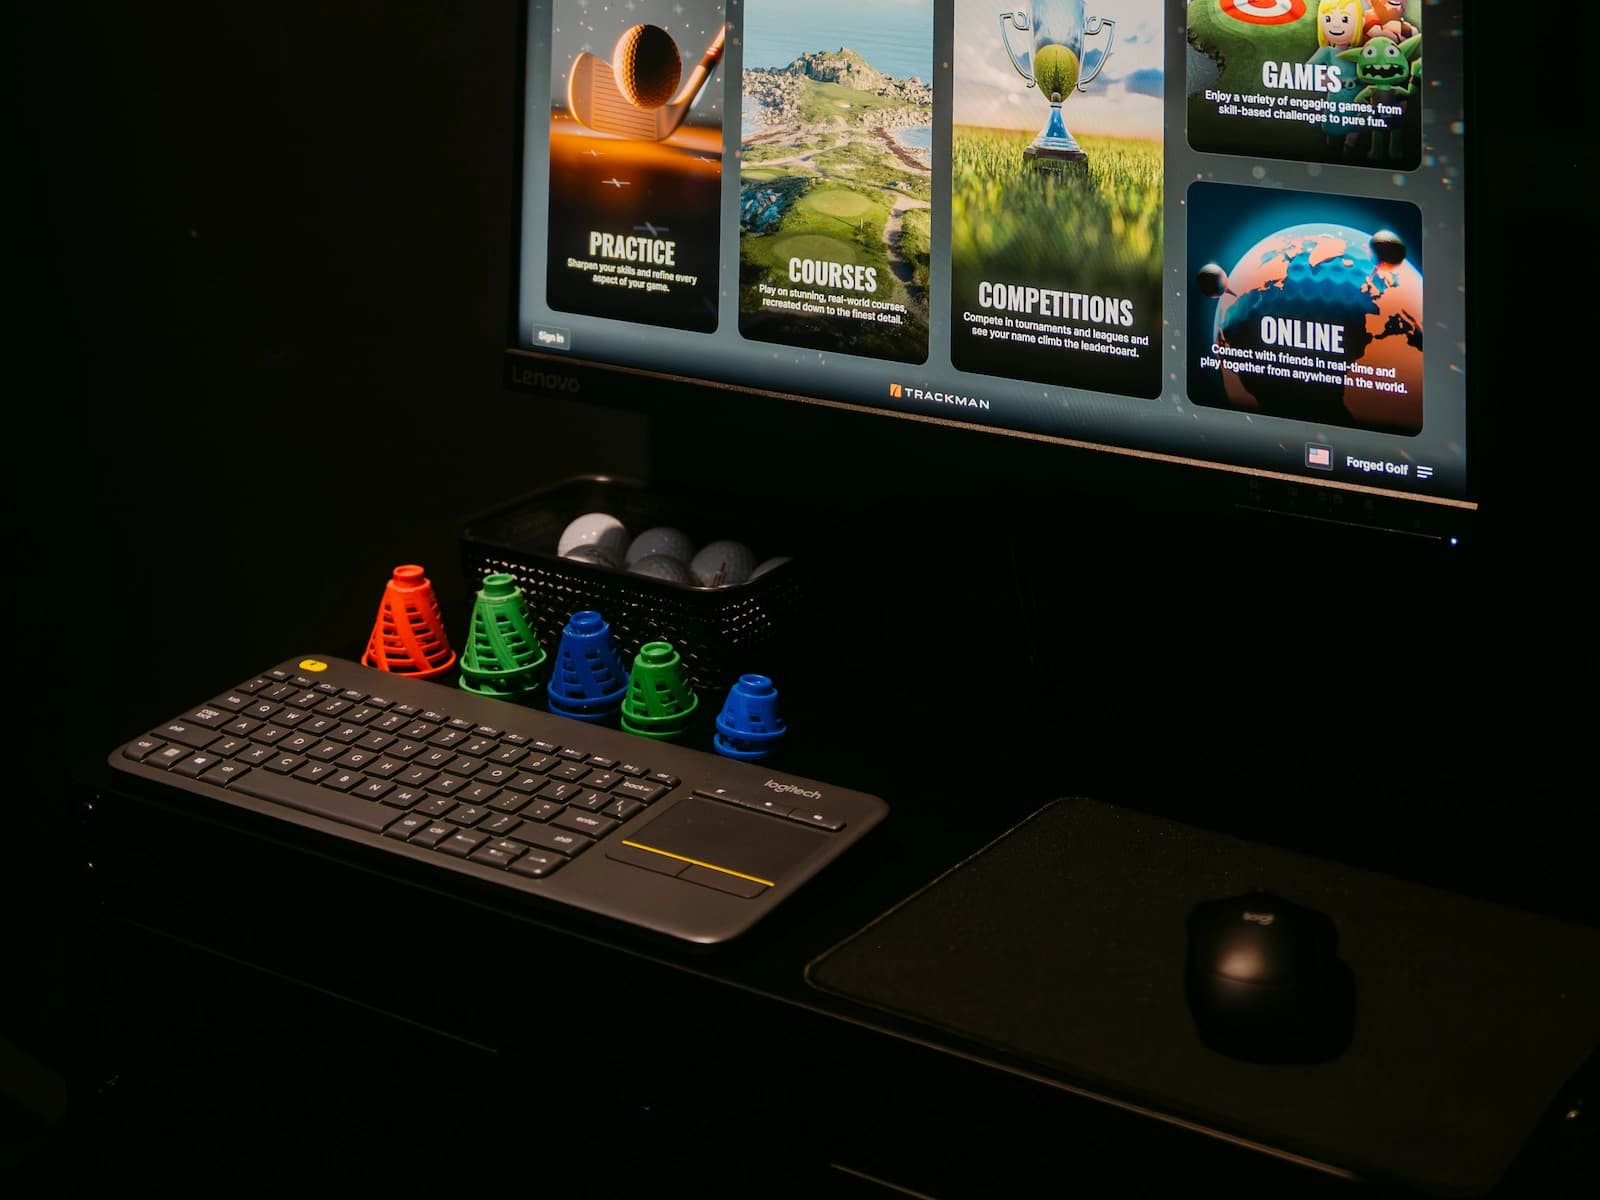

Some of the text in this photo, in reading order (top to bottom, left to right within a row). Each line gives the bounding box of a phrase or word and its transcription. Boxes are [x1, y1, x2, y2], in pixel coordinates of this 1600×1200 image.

[1262, 60, 1342, 93] GAMES
[1204, 89, 1402, 115] Enjoy a variety of engaging games, from
[1218, 104, 1387, 127] skill-based challenges to pure fun.
[589, 231, 675, 266] PRACTICE
[567, 257, 697, 285] Sharpen your skills and refine every
[592, 274, 670, 292] aspect of your game.
[788, 257, 877, 292] COURSES
[758, 283, 907, 314] Play on stunning, real-world courses,
[762, 297, 903, 325] recreated down to the finest detail.
[978, 281, 1133, 326] COMPETITIONS
[538, 330, 564, 343] Sign in
[963, 311, 1149, 345] Compete in tournaments and leagues and
[971, 326, 1139, 357] see your name climb the leaderboard.
[1260, 315, 1344, 353] ONLINE
[1200, 355, 1407, 394] play together from anywhere in the world.
[1211, 343, 1396, 378] Connect with friends in real-time and
[512, 364, 580, 392] Lenovo
[904, 387, 989, 409] TRACKMAN
[1346, 455, 1408, 475] Forged Golf
[763, 779, 821, 799] logitech
[576, 816, 598, 826] enter
